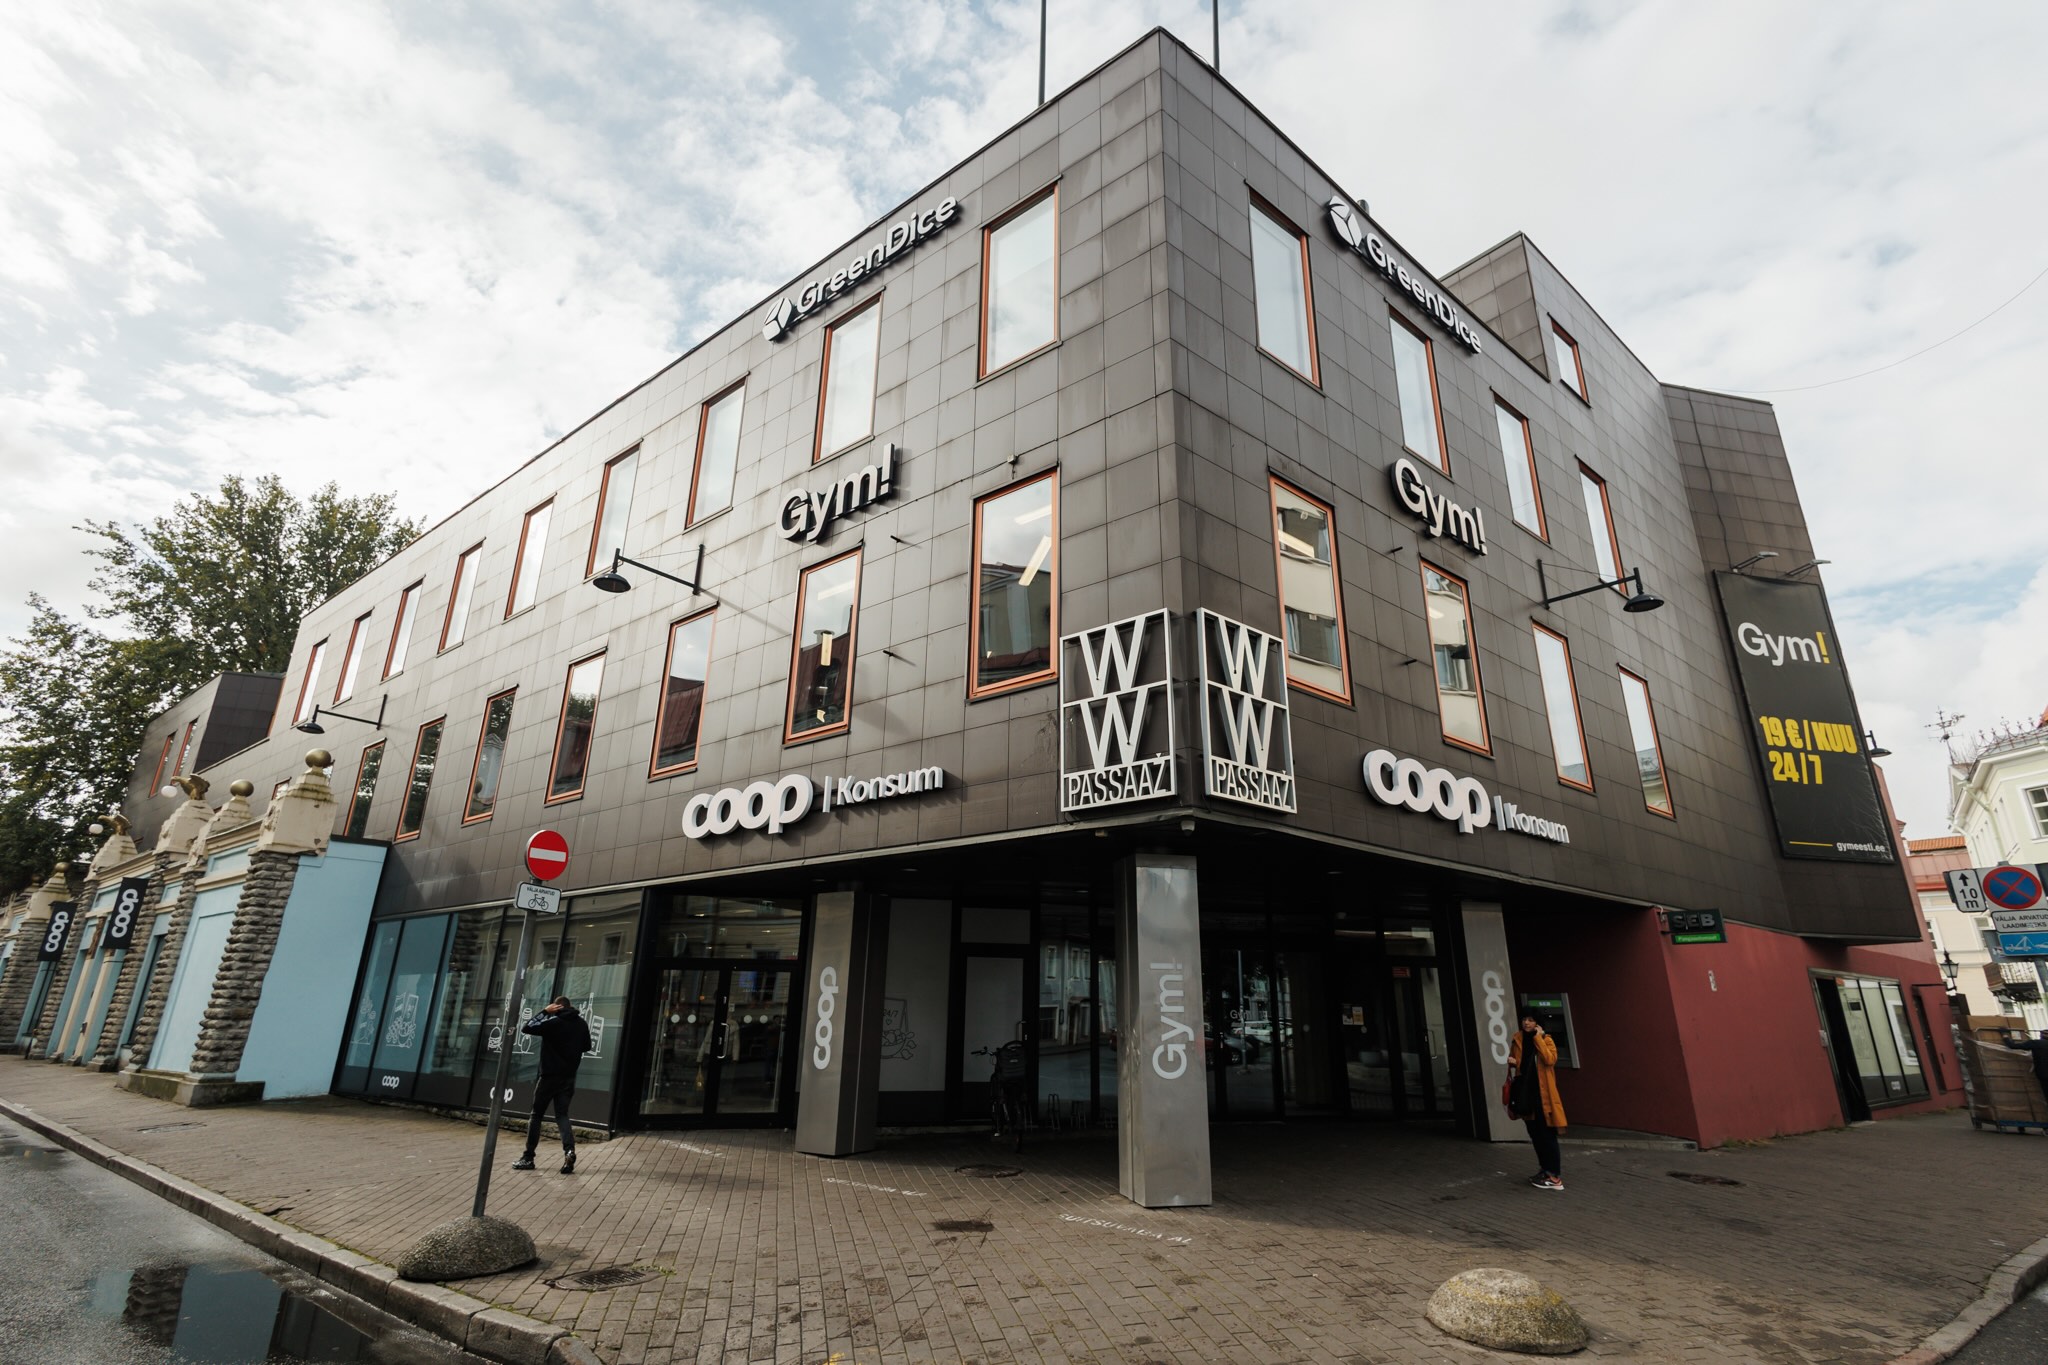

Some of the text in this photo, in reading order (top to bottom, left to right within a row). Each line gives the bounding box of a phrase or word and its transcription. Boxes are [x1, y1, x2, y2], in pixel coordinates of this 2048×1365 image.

[797, 196, 957, 313] GreenDice
[1366, 232, 1481, 353] GreenDice
[776, 443, 895, 542] Gym!
[1392, 458, 1487, 556] Gym!
[1738, 622, 1830, 666] Gym!
[1769, 751, 1823, 784] 24/7
[682, 766, 943, 839] coop Konsum
[1363, 749, 1570, 844] coop Konsum
[1836, 842, 1885, 852] gymeesti.ee
[111, 888, 139, 938] coop
[1960, 888, 1978, 899] 10
[1965, 900, 1979, 909] m
[1994, 914, 2016, 922] VÄLJA
[45, 911, 69, 952] coop
[1673, 913, 1716, 928] SEB
[813, 966, 839, 1070] coop
[1150, 962, 1195, 1080] Gym!
[1482, 970, 1510, 1065] coop
[382, 1075, 400, 1090] coop
